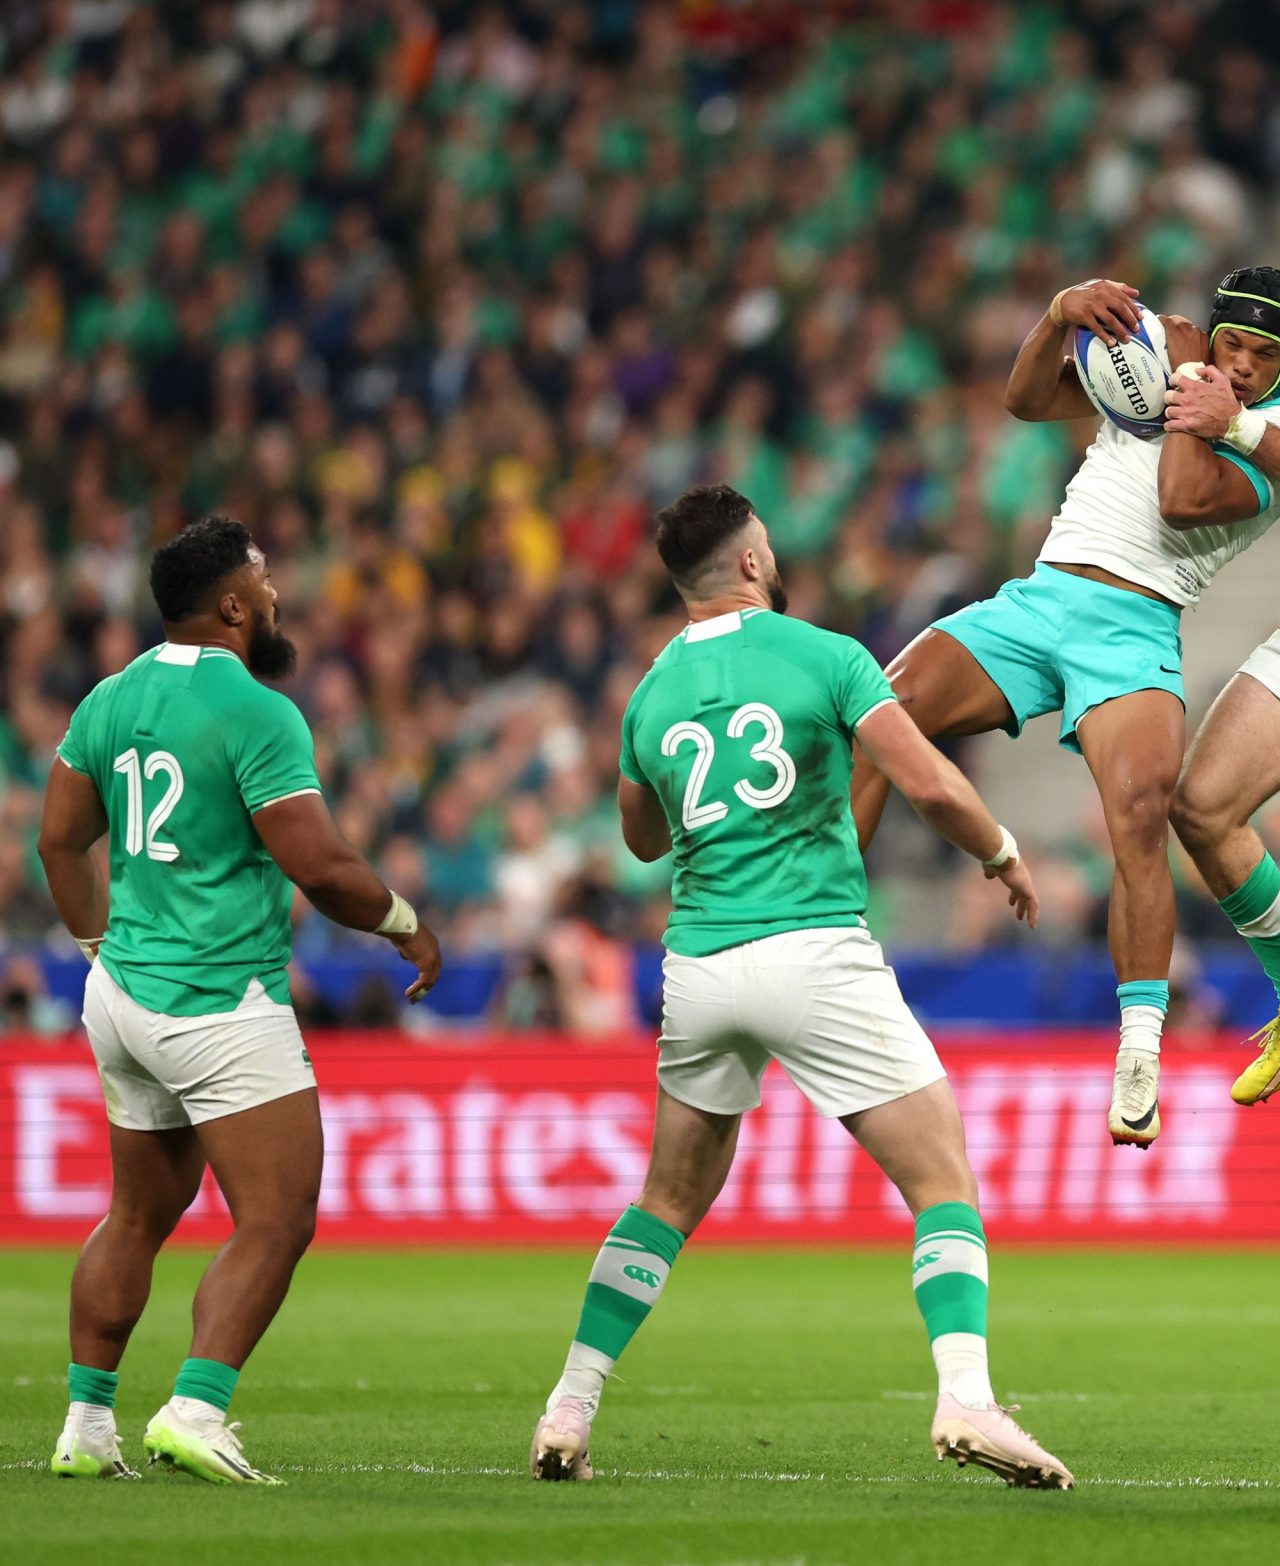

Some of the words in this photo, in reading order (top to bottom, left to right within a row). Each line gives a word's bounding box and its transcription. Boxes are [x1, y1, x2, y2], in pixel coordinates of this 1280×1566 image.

[113, 747, 184, 862] 12
[661, 702, 796, 831] 23
[13, 1063, 652, 1222] Erates
